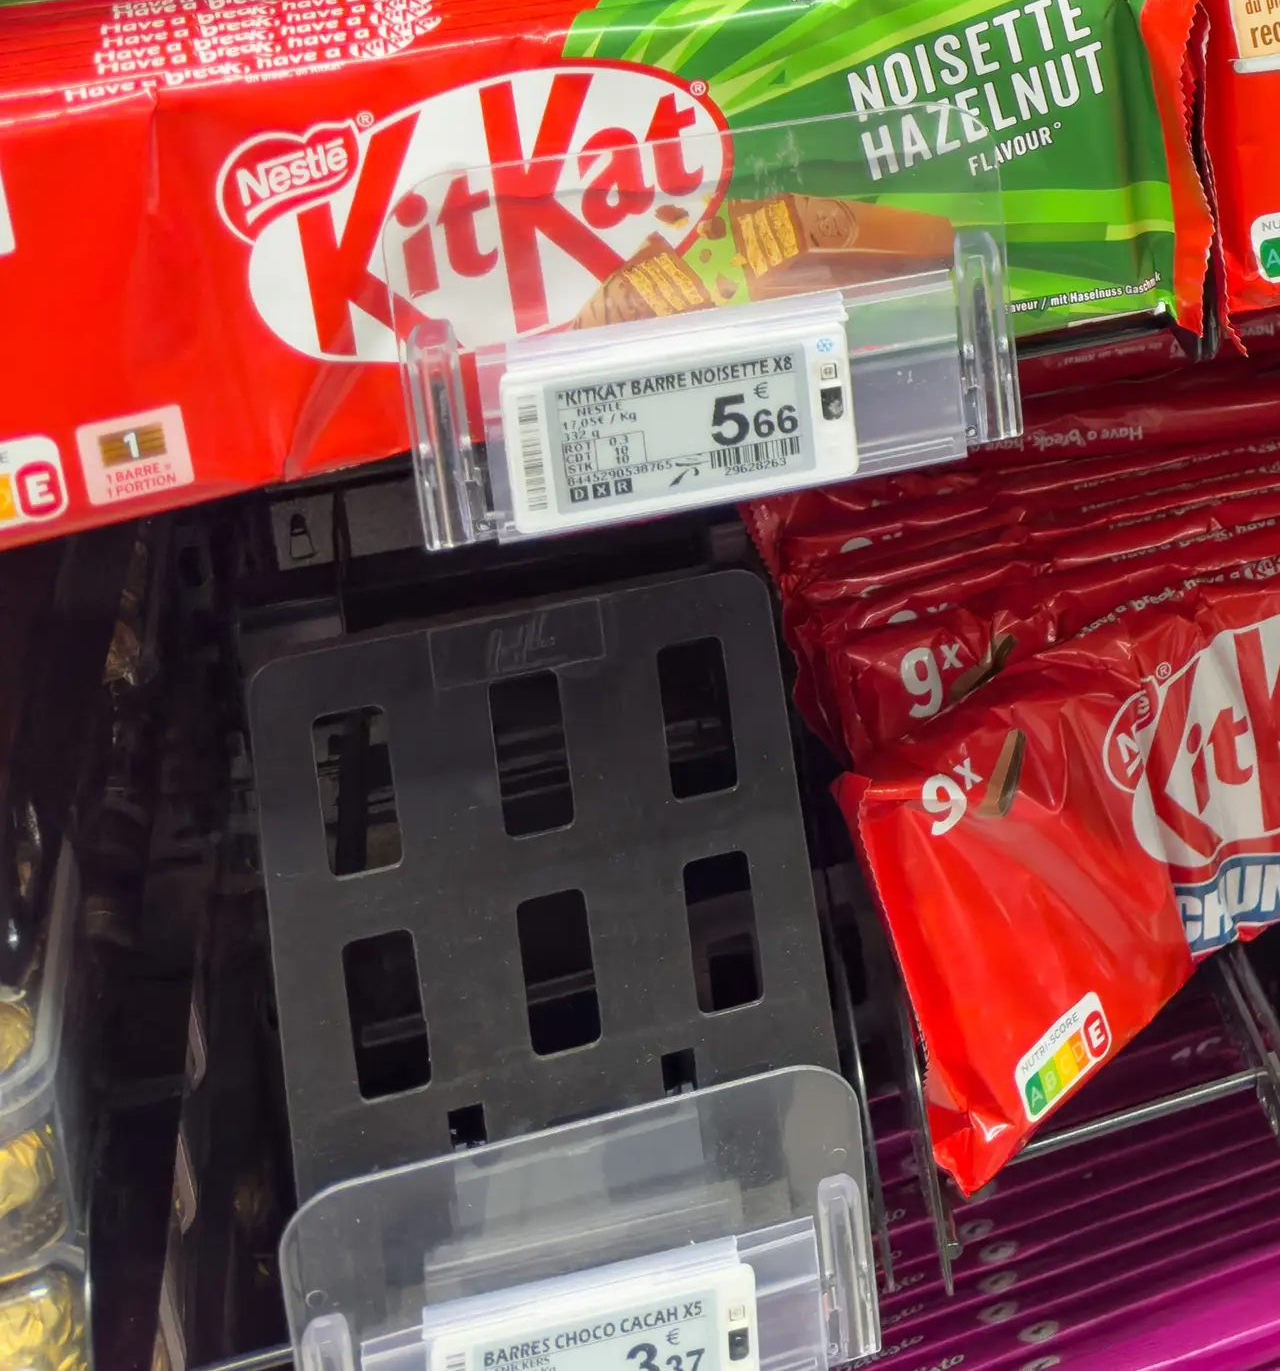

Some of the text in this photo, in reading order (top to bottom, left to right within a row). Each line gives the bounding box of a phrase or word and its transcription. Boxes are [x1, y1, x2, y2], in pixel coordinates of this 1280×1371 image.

[65, 47, 342, 103] Have have a
[860, 40, 1105, 183] HAZELNUT
[235, 142, 350, 205] Nestlé
[294, 71, 708, 361] KitKat
[1050, 286, 1123, 307] mit Haselnuss
[630, 355, 794, 396] BARRE NOISETTE X8
[576, 401, 623, 418] NESTLE
[619, 411, 638, 425] Kg
[123, 431, 140, 459] 1
[563, 431, 588, 442] 332
[564, 442, 592, 455] ROT
[114, 462, 162, 482] BARRE
[567, 461, 594, 474] STK
[116, 473, 177, 496] PORTION
[1020, 1011, 1080, 1076] NUTRI-SCORE
[483, 1300, 703, 1368] BARRES CHOCO CACAH X5
